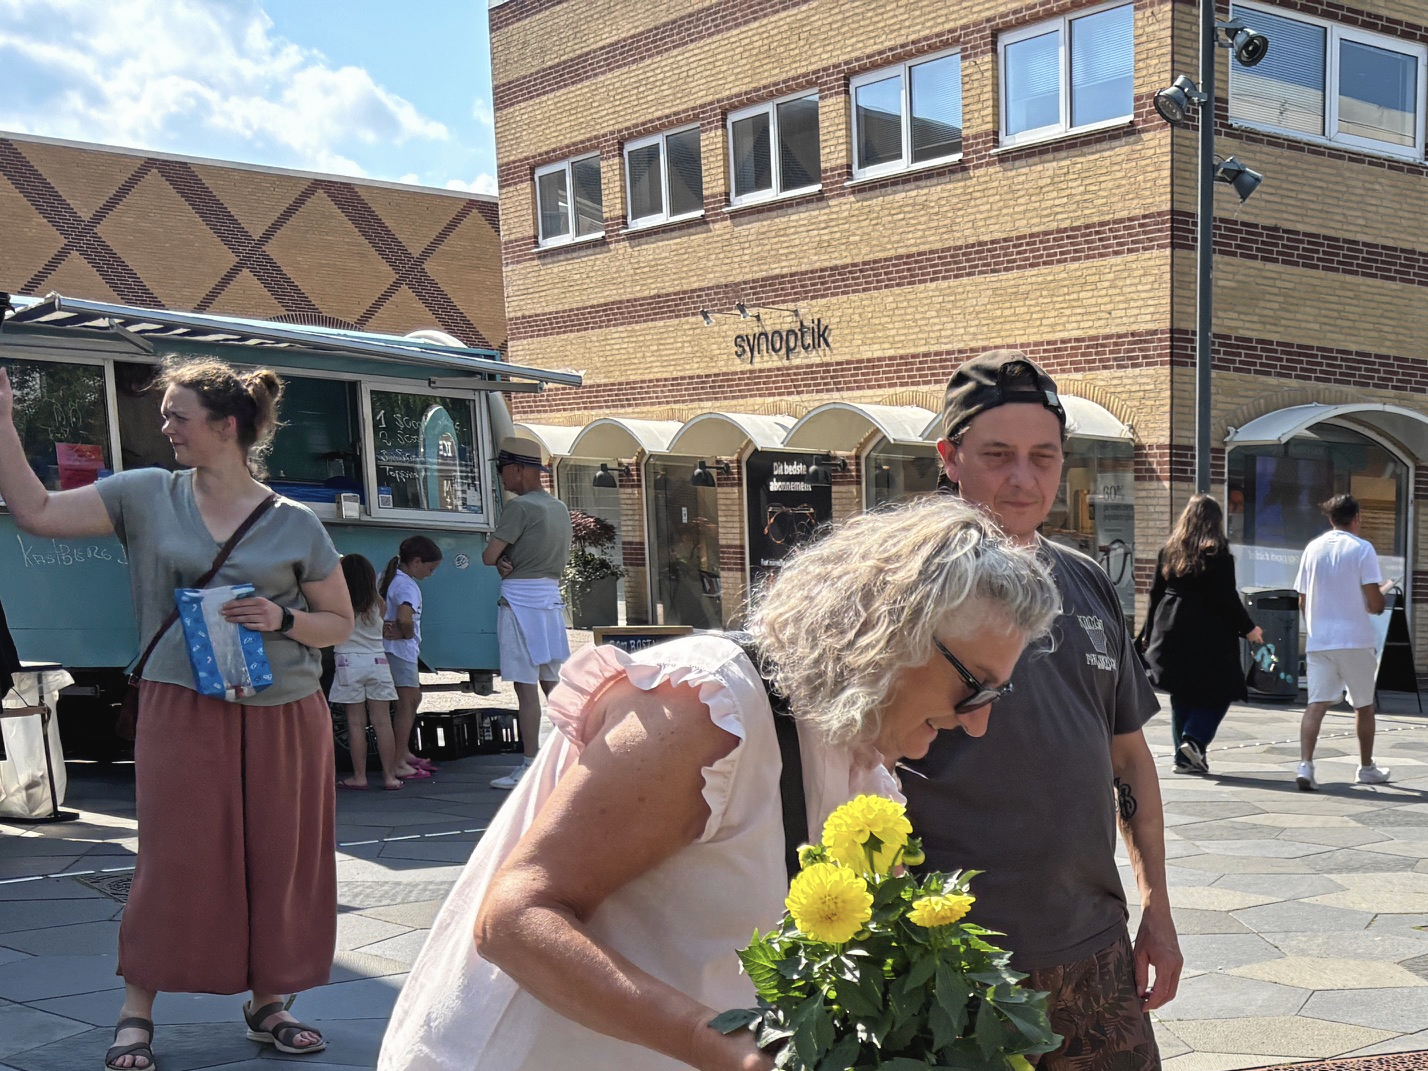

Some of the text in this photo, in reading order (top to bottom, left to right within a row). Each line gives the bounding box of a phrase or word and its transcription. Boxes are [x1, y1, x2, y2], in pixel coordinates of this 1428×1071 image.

[734, 318, 831, 365] synoptik
[772, 460, 808, 475] Dit bedste
